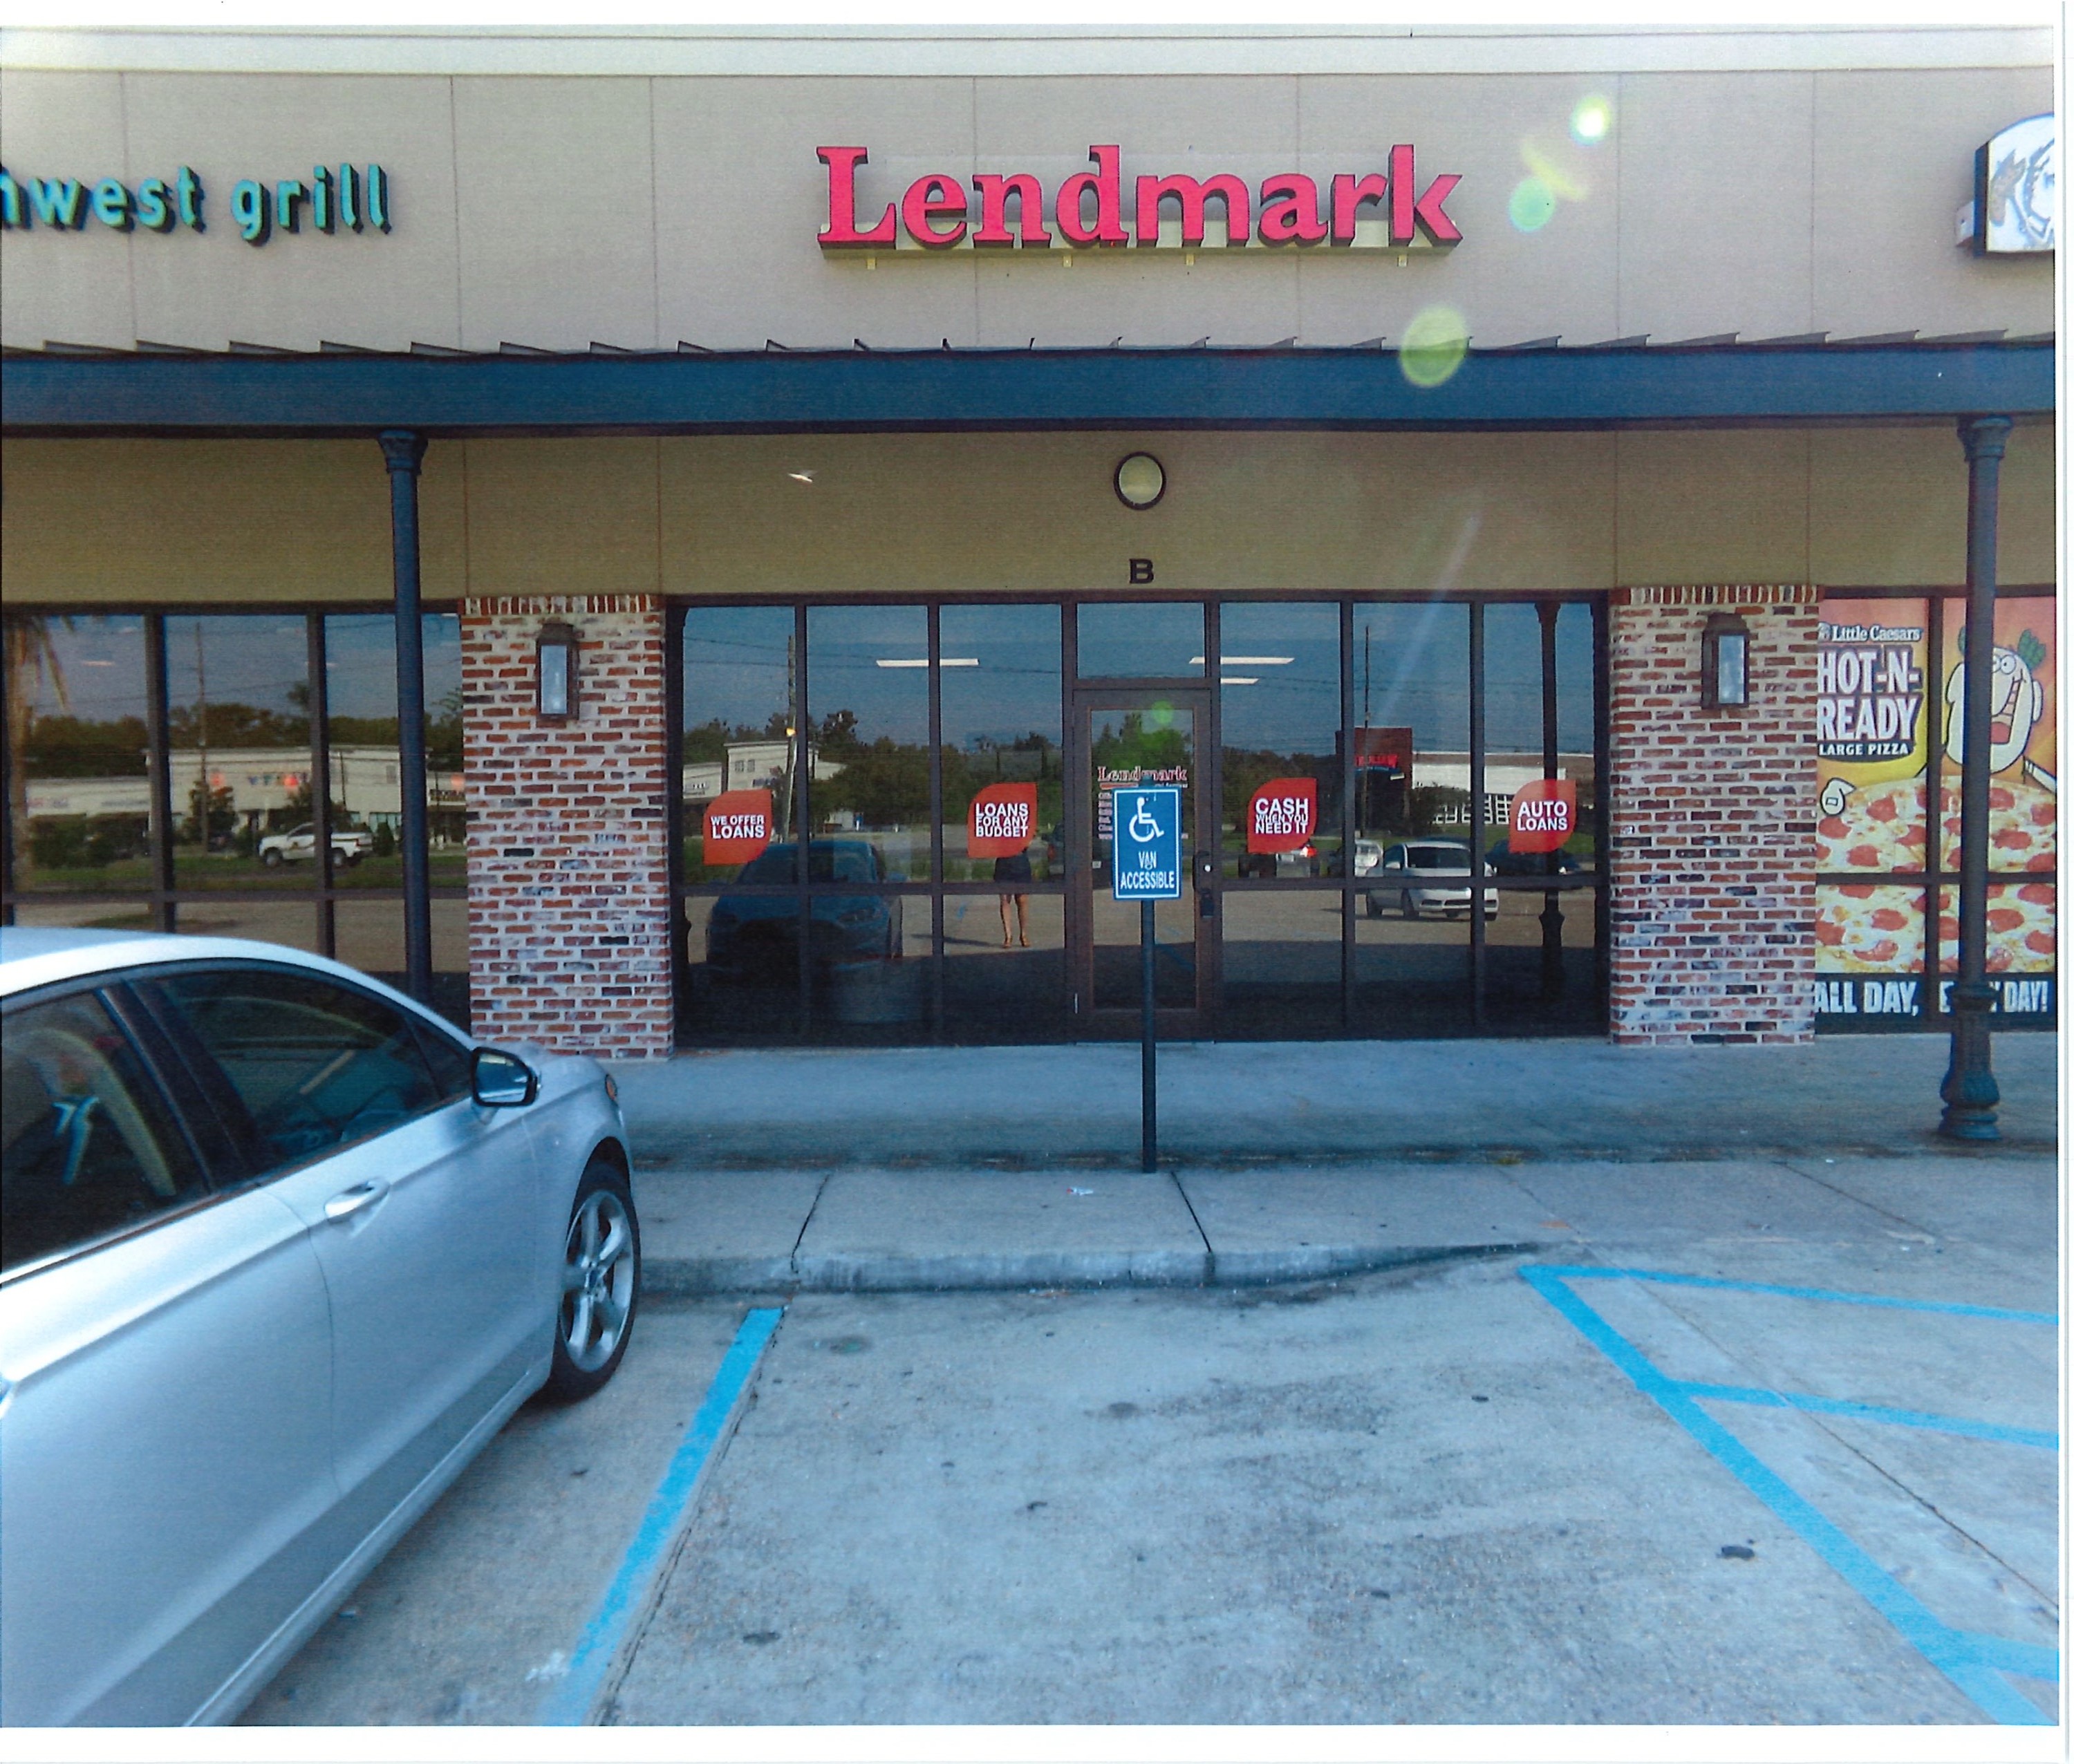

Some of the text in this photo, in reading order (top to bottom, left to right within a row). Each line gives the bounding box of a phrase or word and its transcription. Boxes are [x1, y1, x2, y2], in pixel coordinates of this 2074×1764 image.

[231, 162, 392, 246] grill
[816, 144, 1464, 249] Lendmark
[1129, 559, 1155, 584] B
[1832, 624, 1922, 641] Little Caesars
[1818, 650, 1921, 694] HOT-N-
[1817, 697, 1918, 741] READY
[1819, 744, 1909, 756] LARGE PIZZA
[975, 803, 1029, 817] LOANS
[1255, 798, 1309, 815] CASH
[1517, 800, 1567, 817] AUTO
[711, 814, 765, 825] WE OFFER
[975, 816, 1028, 827] FOR ANY
[1255, 814, 1308, 823] WHEN YOU
[1517, 817, 1567, 831] LOANS
[712, 825, 765, 839] LOANS
[975, 825, 1029, 837] BUDGET
[1255, 822, 1308, 834] NEED IT
[1138, 852, 1157, 869] VAN
[1120, 871, 1175, 889] ACCESSIBLE
[1814, 981, 1857, 1013] ALL
[1864, 981, 1919, 1016] DAY,
[2004, 981, 2048, 1013] DAY!
